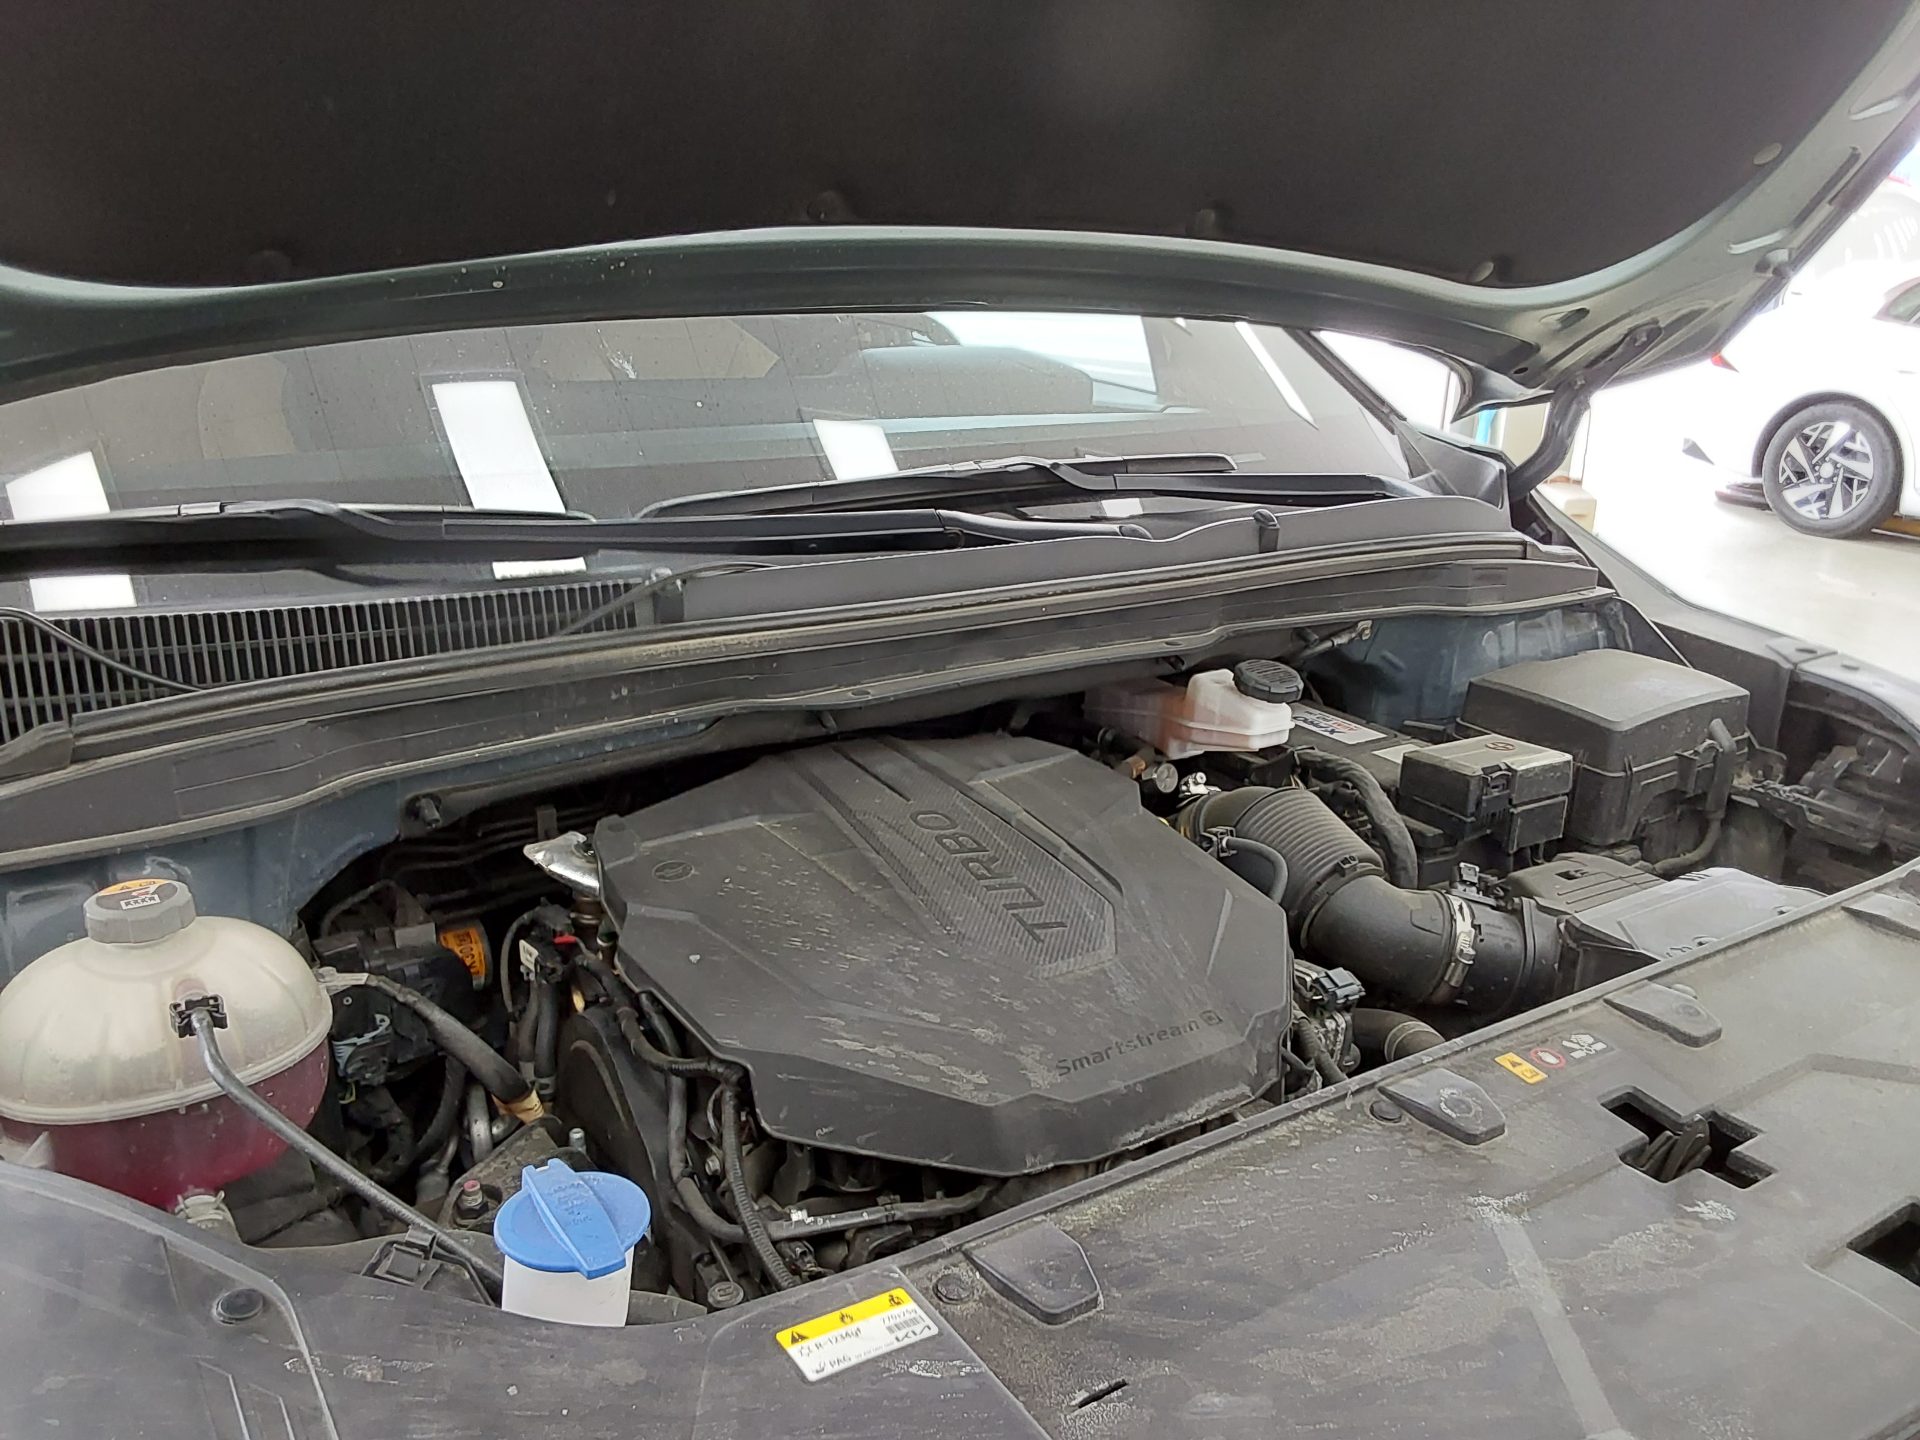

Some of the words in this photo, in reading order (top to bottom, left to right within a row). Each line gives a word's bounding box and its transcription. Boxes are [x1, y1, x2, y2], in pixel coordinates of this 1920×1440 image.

[909, 810, 1068, 944] TURBO
[1055, 1019, 1200, 1077] Smartstream
[894, 1324, 932, 1343] KIA
